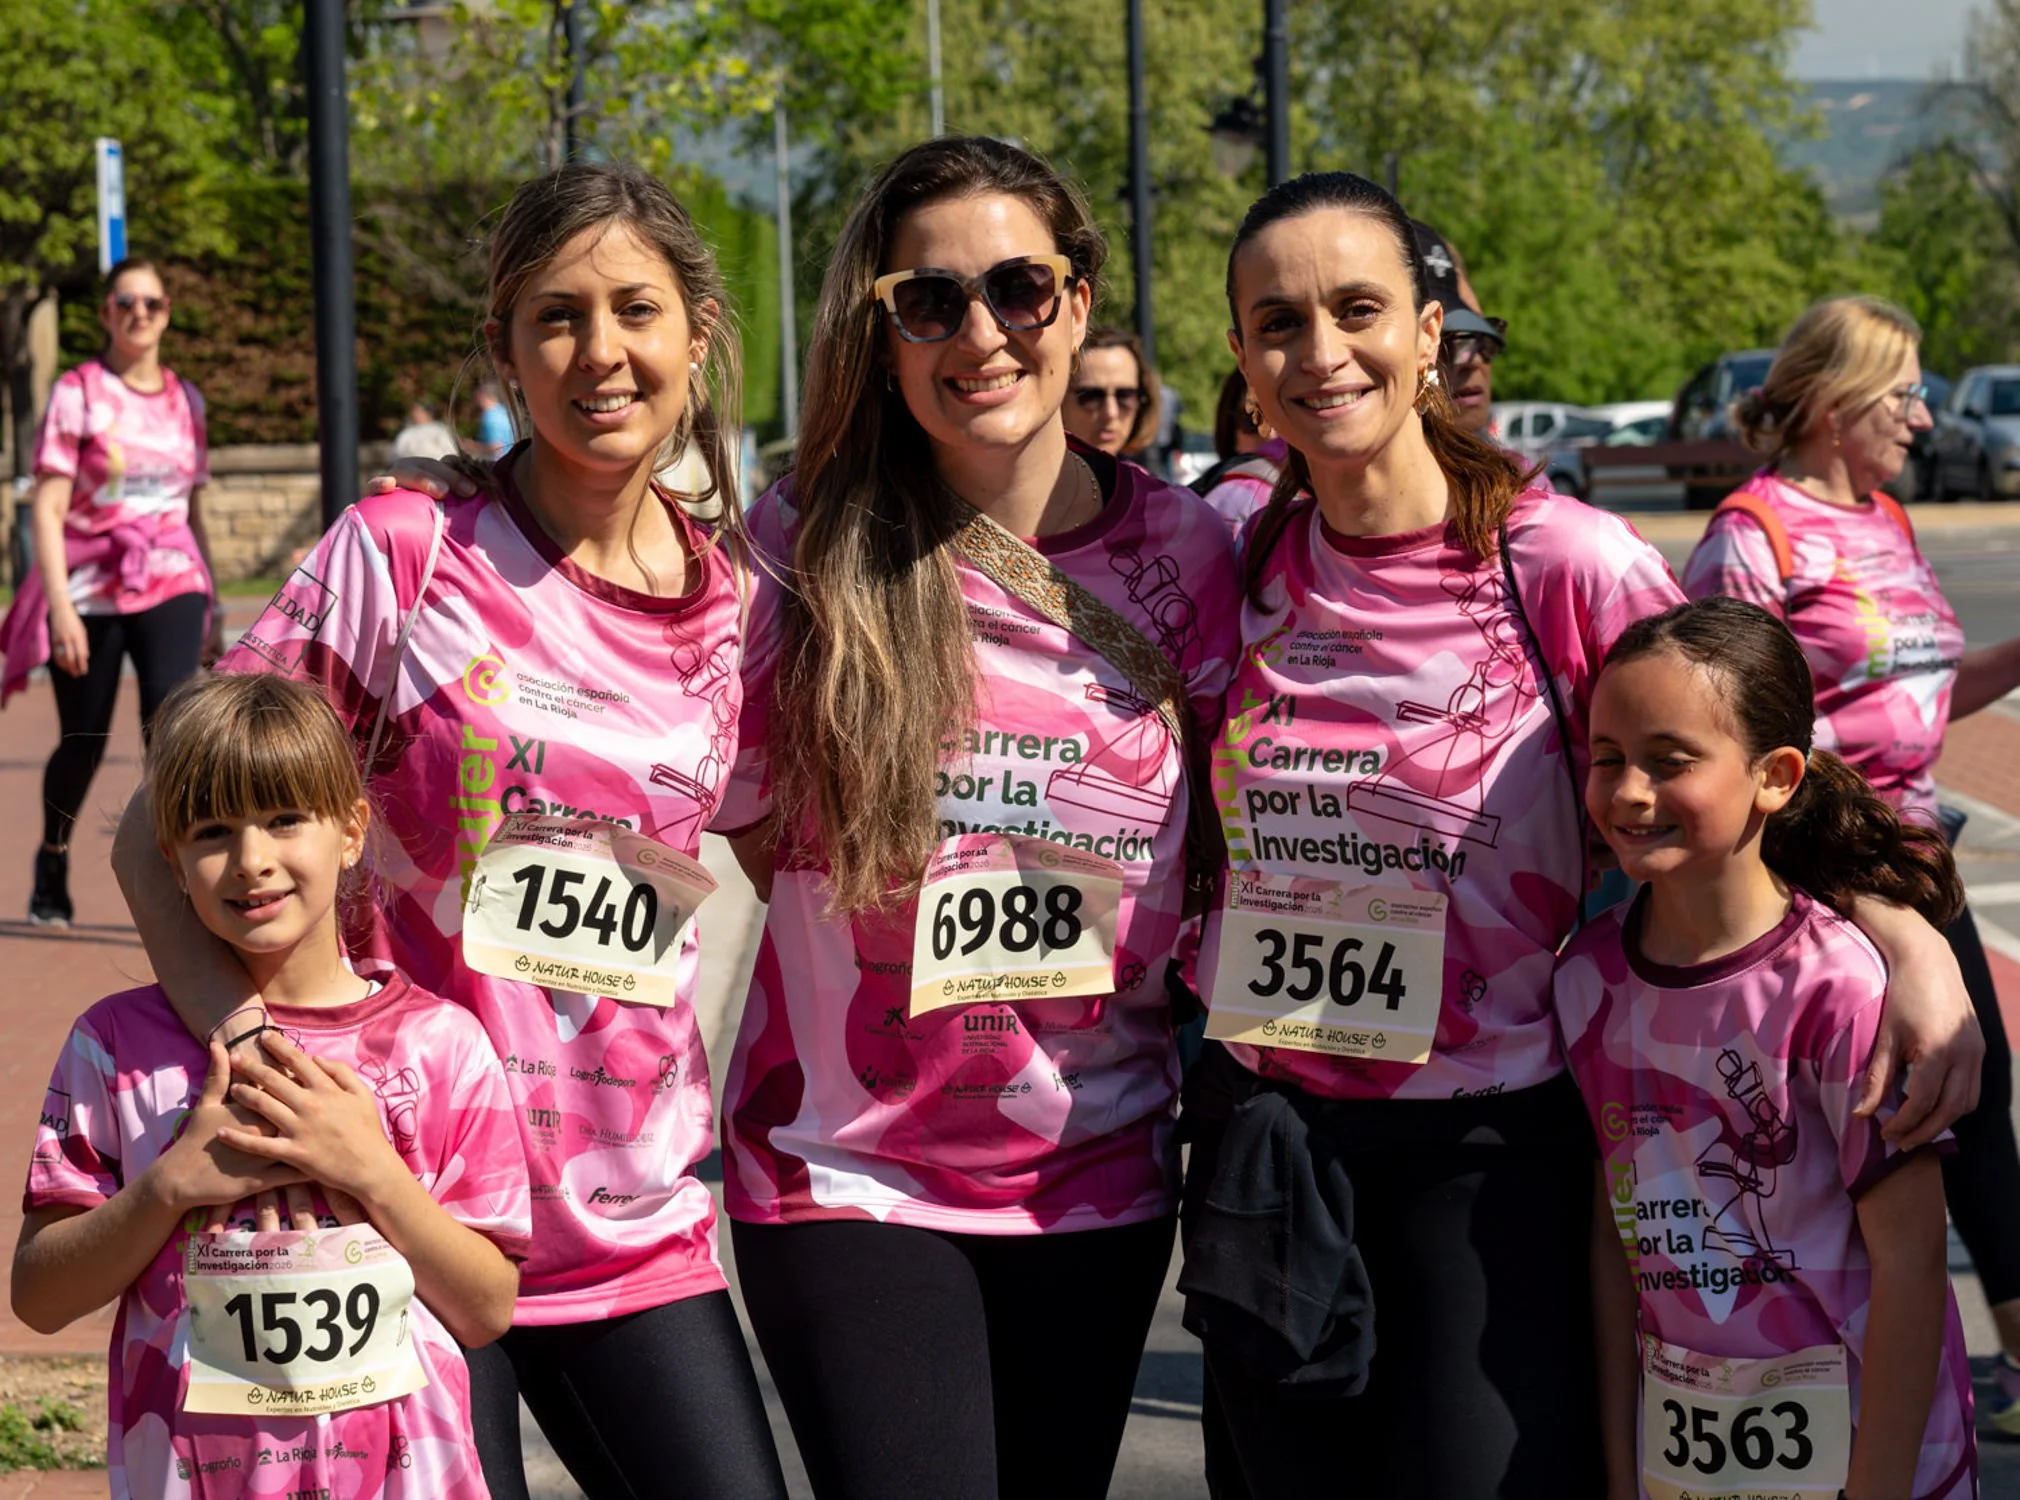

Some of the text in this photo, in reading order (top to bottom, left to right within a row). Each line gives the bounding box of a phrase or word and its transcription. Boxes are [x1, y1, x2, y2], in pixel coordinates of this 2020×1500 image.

[981, 632, 1010, 647] Rioja
[988, 621, 998, 630] el
[1001, 622, 1041, 635] cáncer
[1330, 642, 1363, 654] cáncer
[1287, 655, 1336, 669] en La Rioja
[517, 671, 630, 704] asociación española
[518, 682, 605, 714] contra el cáncer
[519, 696, 578, 719] en La Rioja
[1260, 693, 1296, 727] XI
[505, 735, 546, 775] XI
[1248, 736, 1382, 775] Carrera
[1001, 770, 1037, 807] la
[1246, 784, 1343, 823] por la
[564, 827, 582, 837] por
[583, 828, 593, 840] la
[938, 818, 1155, 861] nvestigación
[959, 849, 974, 859] por
[1252, 827, 1467, 884] Investigación
[1240, 880, 1321, 902] XI Carrera por la
[512, 864, 658, 952] 1540
[932, 884, 1083, 961] 6988
[532, 961, 622, 987] NATUR HOUSE
[866, 961, 913, 976] ogroñ
[1247, 928, 1406, 1011] 3564
[1005, 976, 1049, 989] HOUSE
[1279, 1024, 1370, 1046] NATUR HOUSE
[520, 1059, 535, 1074] La
[1636, 1198, 1711, 1221] arrer
[197, 1243, 289, 1259] XI Carrera por la
[1637, 1228, 1694, 1257] or la
[224, 1282, 380, 1365] 1539
[1685, 1364, 1700, 1376] por
[1701, 1367, 1710, 1377] la
[266, 1382, 358, 1404] NATUR HOUSE
[1663, 1398, 1813, 1475] 3563
[198, 1456, 241, 1475] ogroño
[276, 1450, 290, 1463] La
[292, 1448, 317, 1463] Rioja
